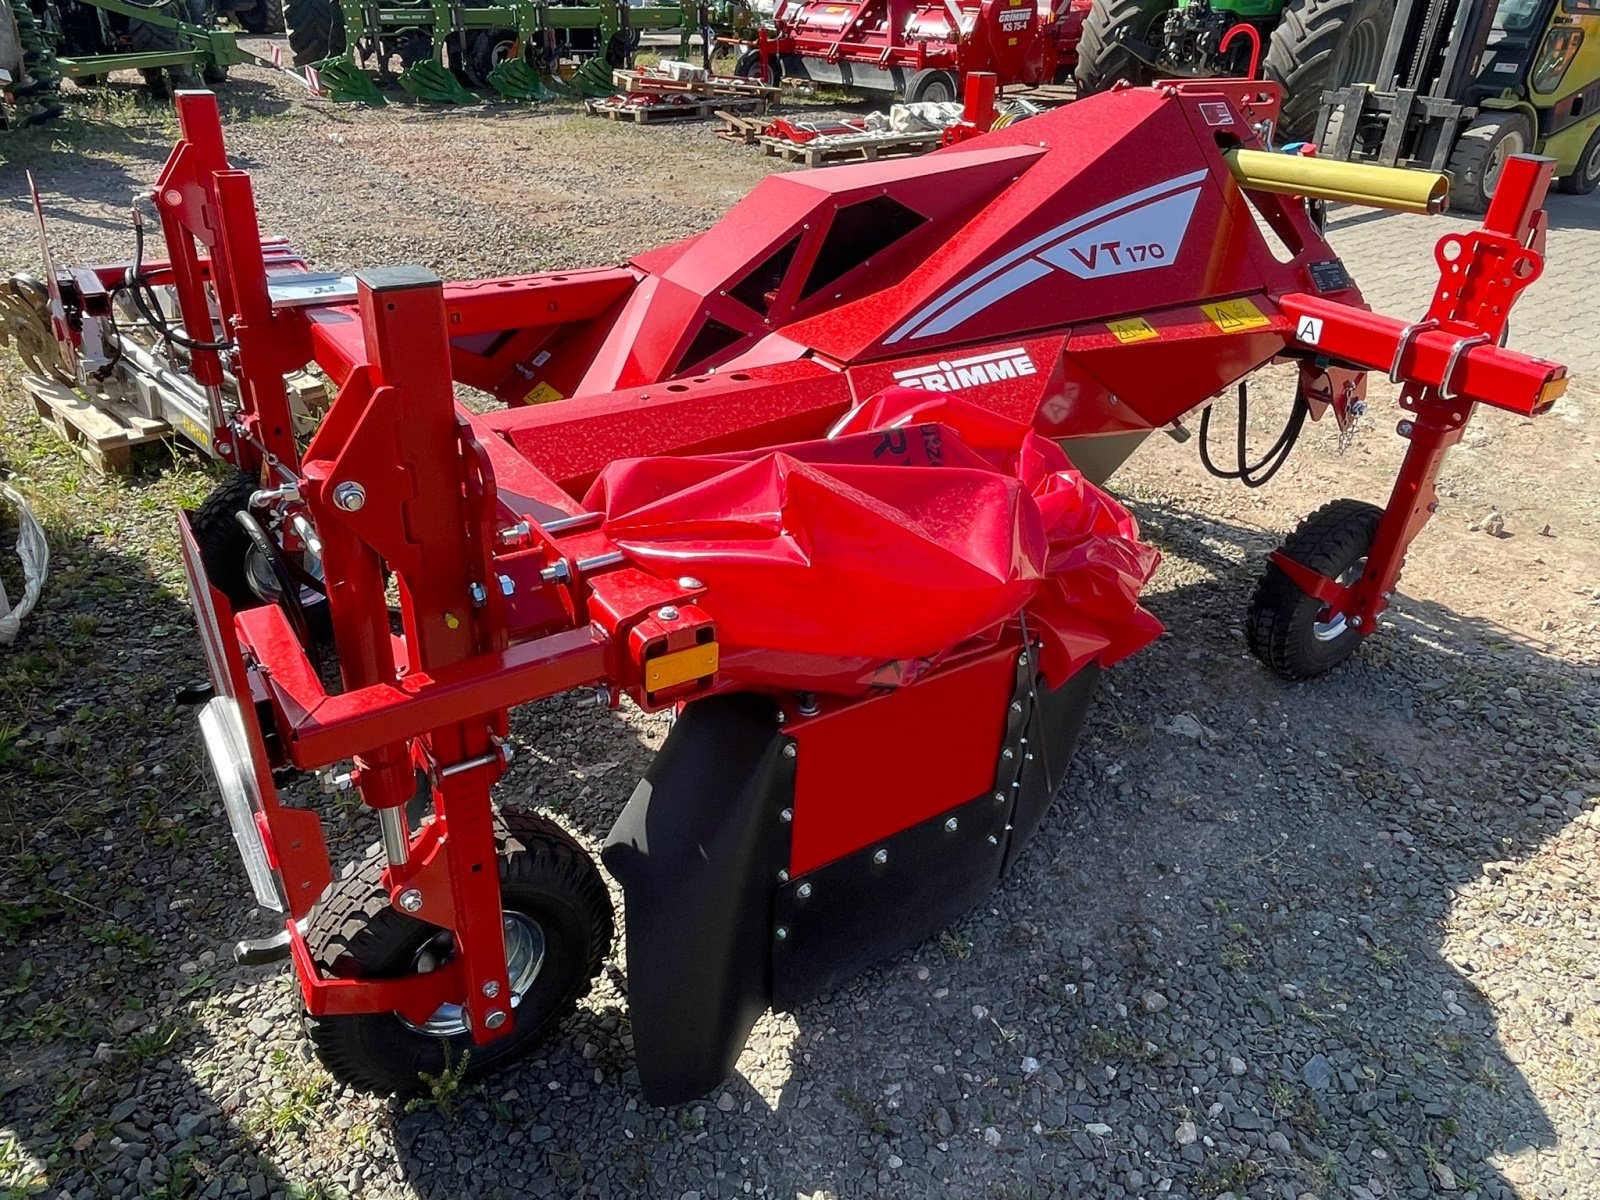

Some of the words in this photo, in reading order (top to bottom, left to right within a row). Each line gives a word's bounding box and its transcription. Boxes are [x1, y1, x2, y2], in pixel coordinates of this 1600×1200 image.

[999, 10, 1032, 22] GRIMME
[1003, 22, 1012, 32] KS
[1068, 241, 1122, 270] VT
[1125, 243, 1165, 263] 170
[1300, 320, 1315, 341] A
